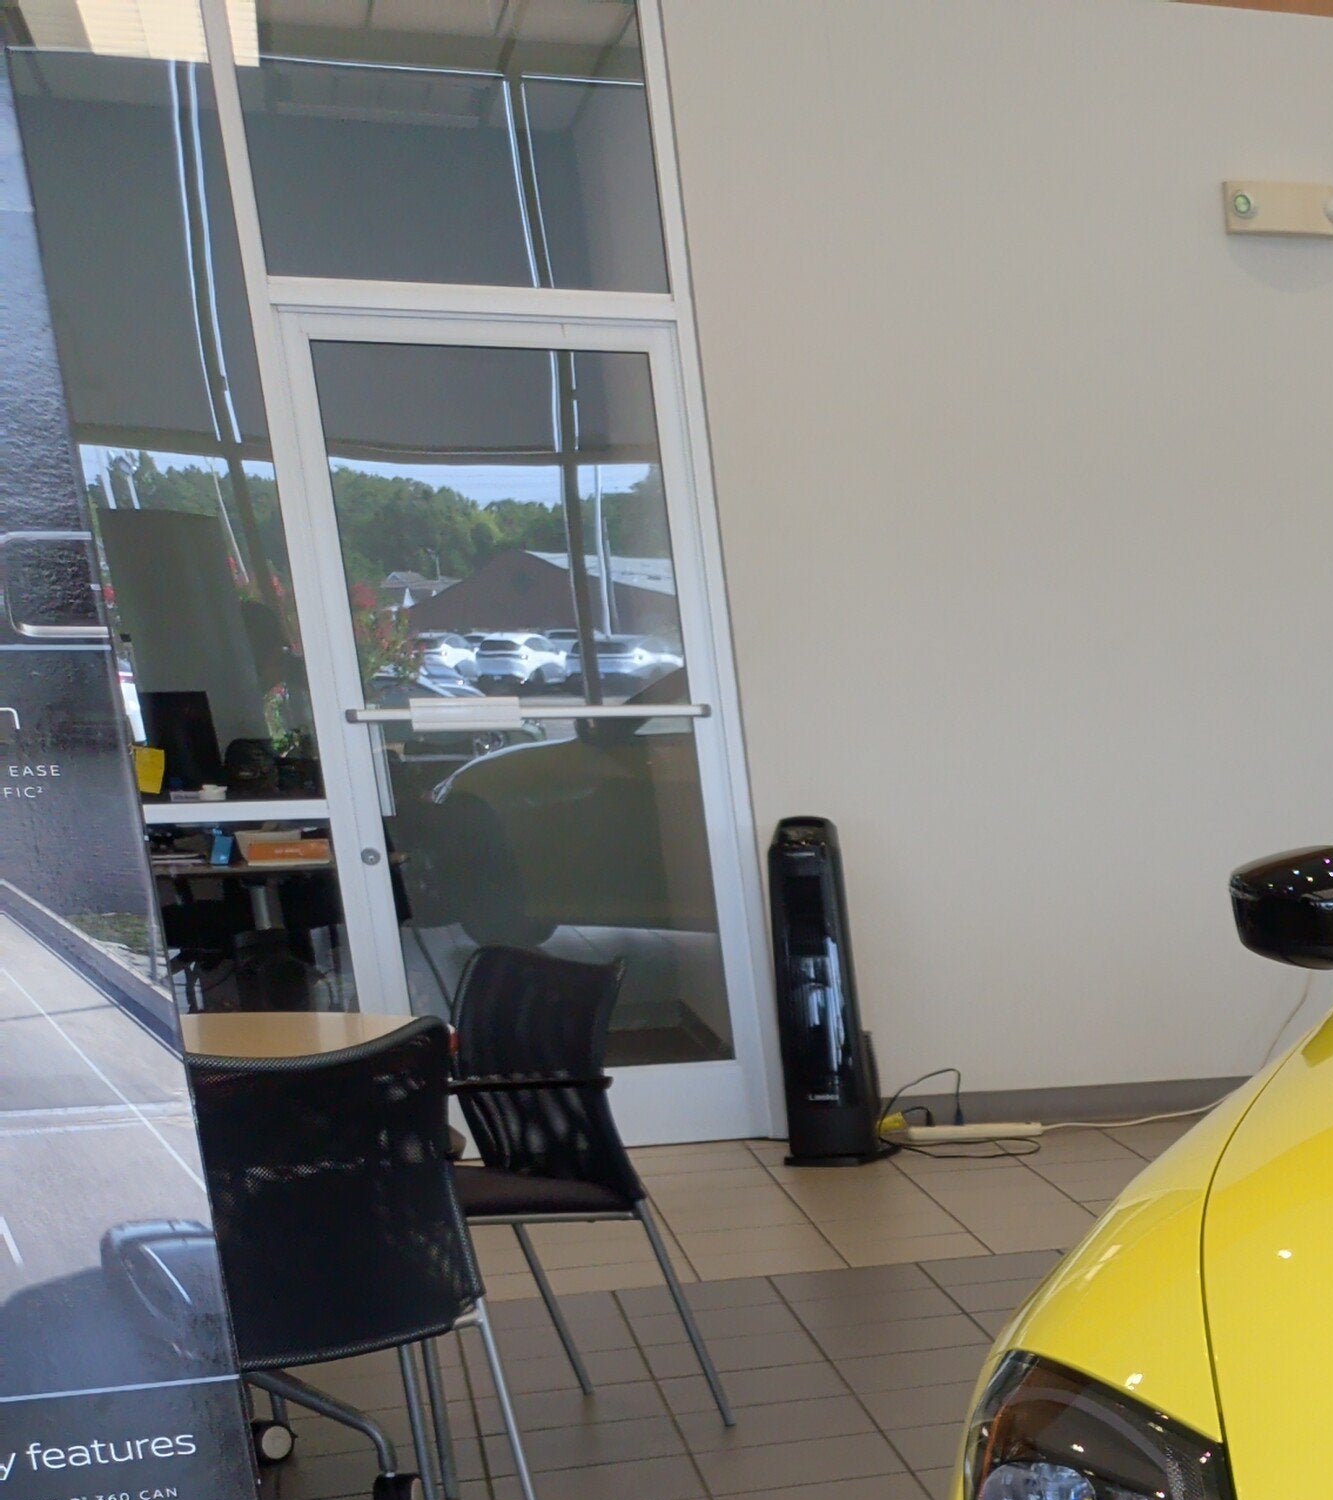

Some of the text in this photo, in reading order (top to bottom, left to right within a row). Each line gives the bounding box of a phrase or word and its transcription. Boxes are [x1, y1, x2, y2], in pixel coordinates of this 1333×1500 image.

[9, 765, 61, 777] EASE
[26, 1433, 197, 1471] features
[139, 1486, 178, 1500] CAN
